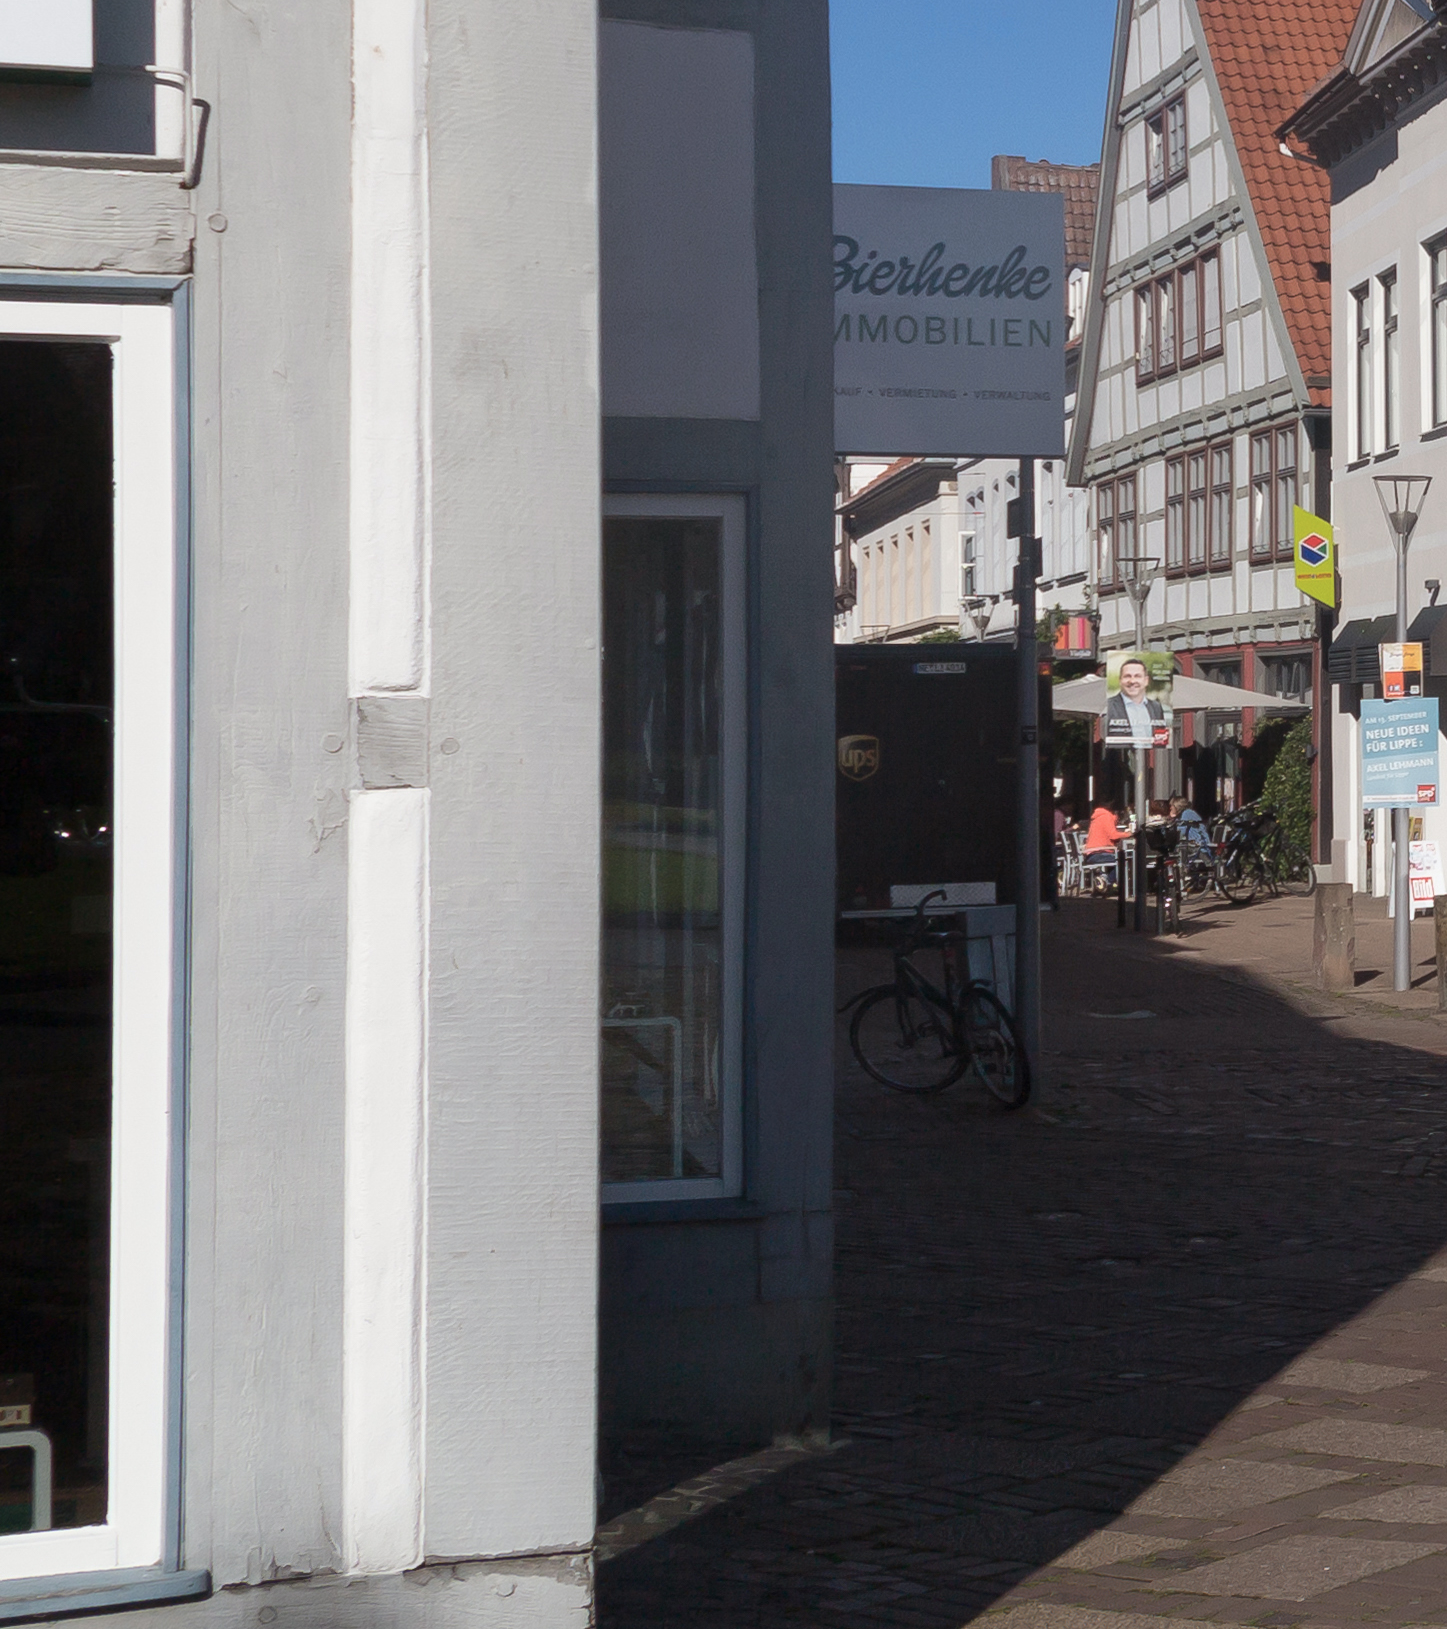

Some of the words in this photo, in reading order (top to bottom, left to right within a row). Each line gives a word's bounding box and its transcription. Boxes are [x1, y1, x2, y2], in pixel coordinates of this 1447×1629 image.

[833, 314, 1051, 348] MMOBILIEN
[879, 388, 957, 399] VERMIETUNG
[974, 390, 1051, 401] VERWALTUNG
[1366, 728, 1395, 739] NEUE
[1397, 724, 1429, 736] IDEEN
[1366, 740, 1387, 753] FÜR
[1366, 763, 1388, 773] AXEL
[1390, 758, 1434, 770] LEHMANN
